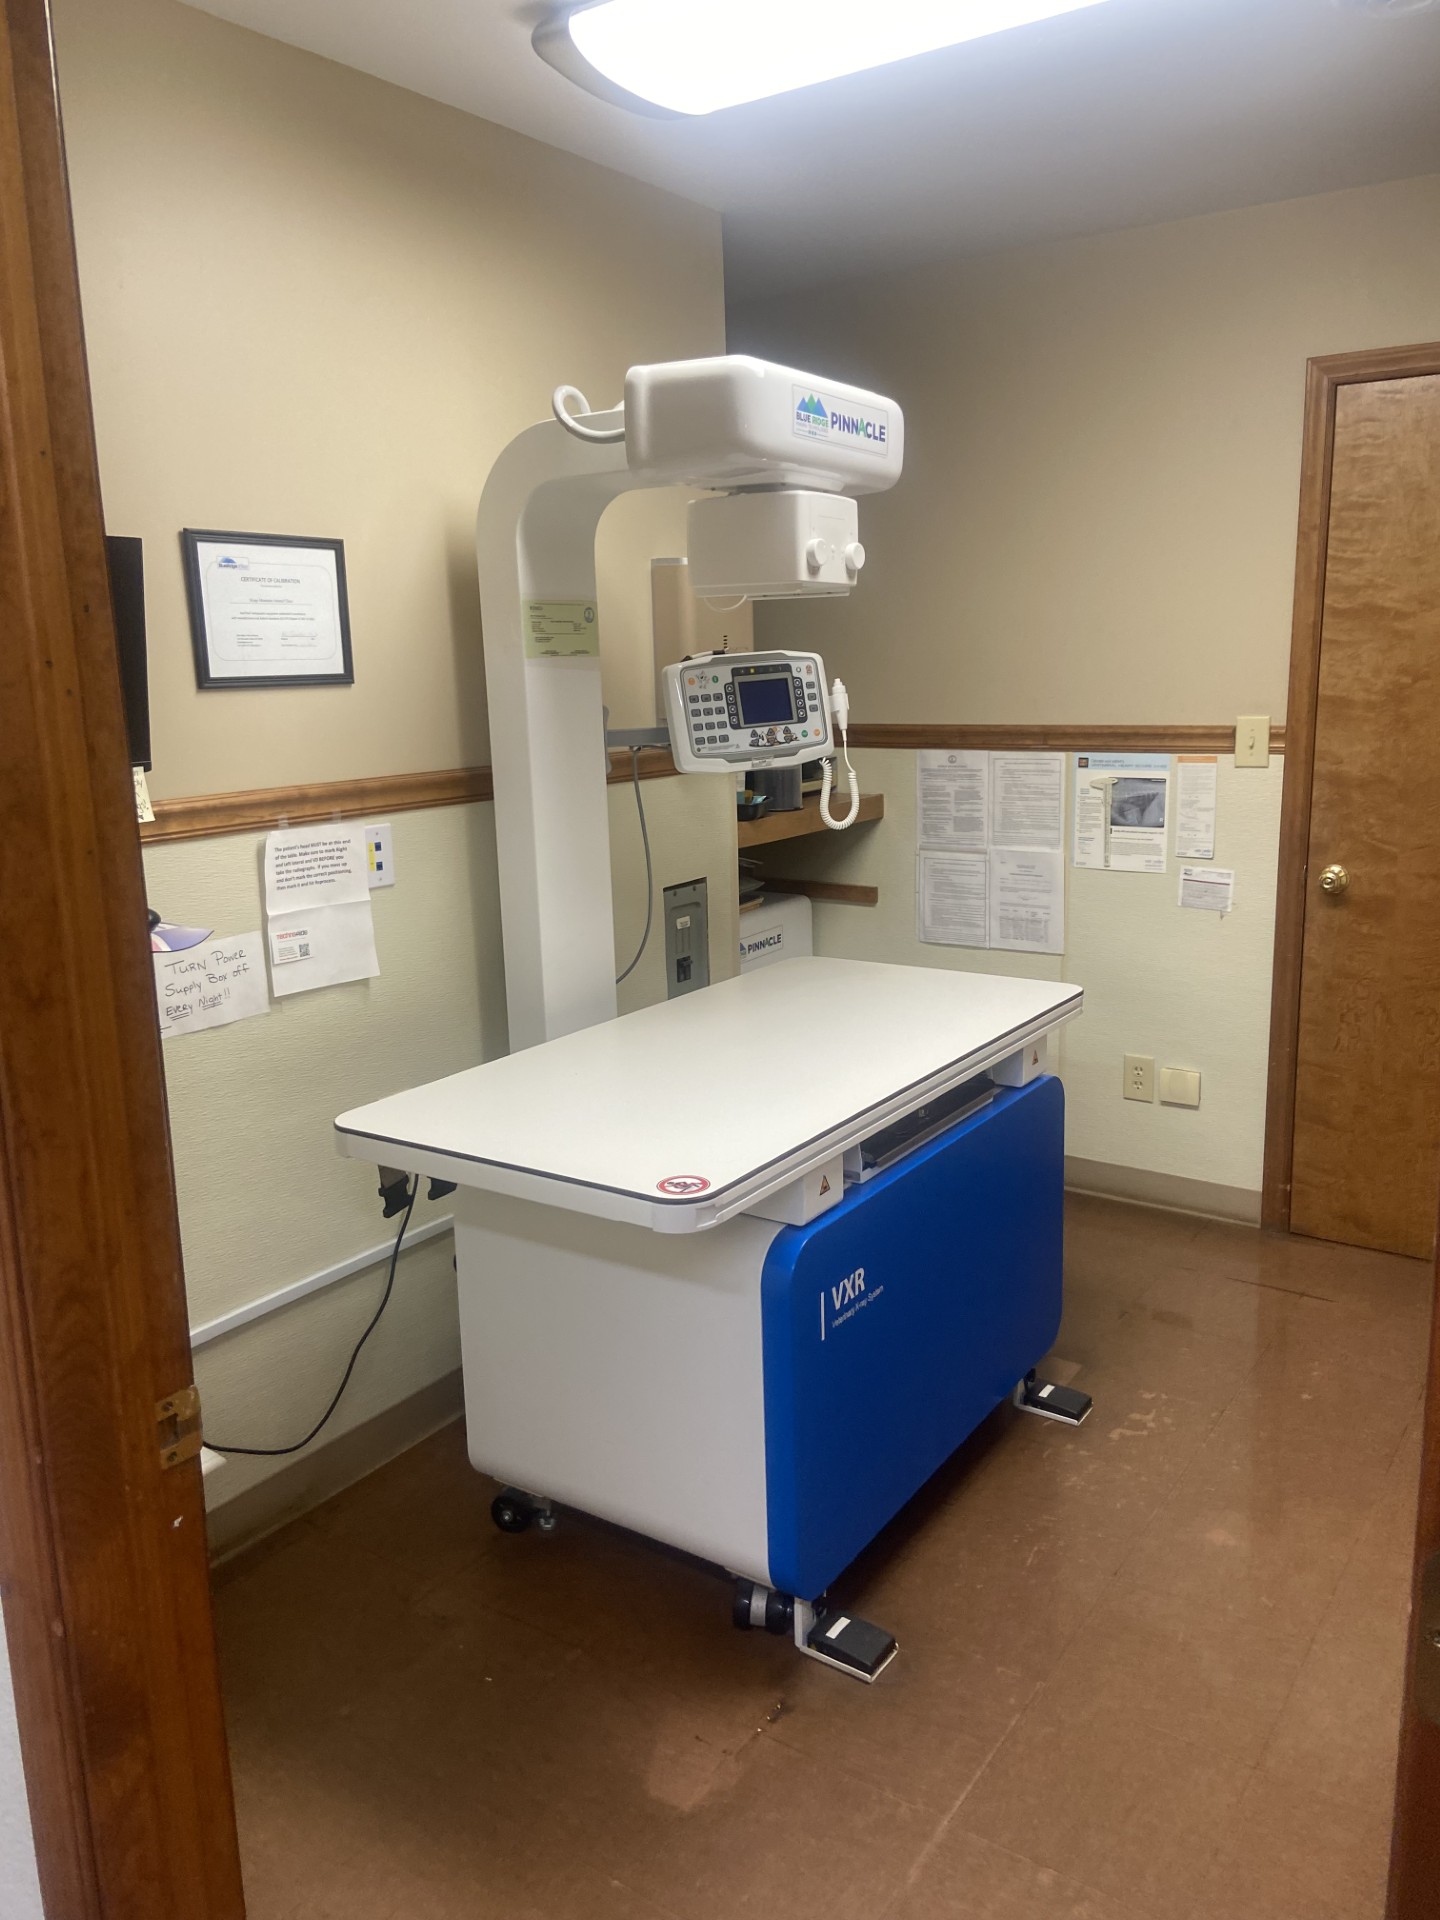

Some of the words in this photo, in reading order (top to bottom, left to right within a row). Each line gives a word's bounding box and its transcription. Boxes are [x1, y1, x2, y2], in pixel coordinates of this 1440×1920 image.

[796, 411, 811, 422] BLUE
[812, 416, 829, 428] RIDGE
[831, 412, 885, 442] PINNACLE
[747, 933, 782, 955] PINNACLE
[164, 960, 207, 975] TURN
[165, 981, 202, 997] Supply
[205, 973, 228, 984] Box
[232, 963, 250, 977] off
[831, 1267, 865, 1310] VXR
[831, 1307, 856, 1328] Veterinary
[867, 1285, 884, 1302] System
